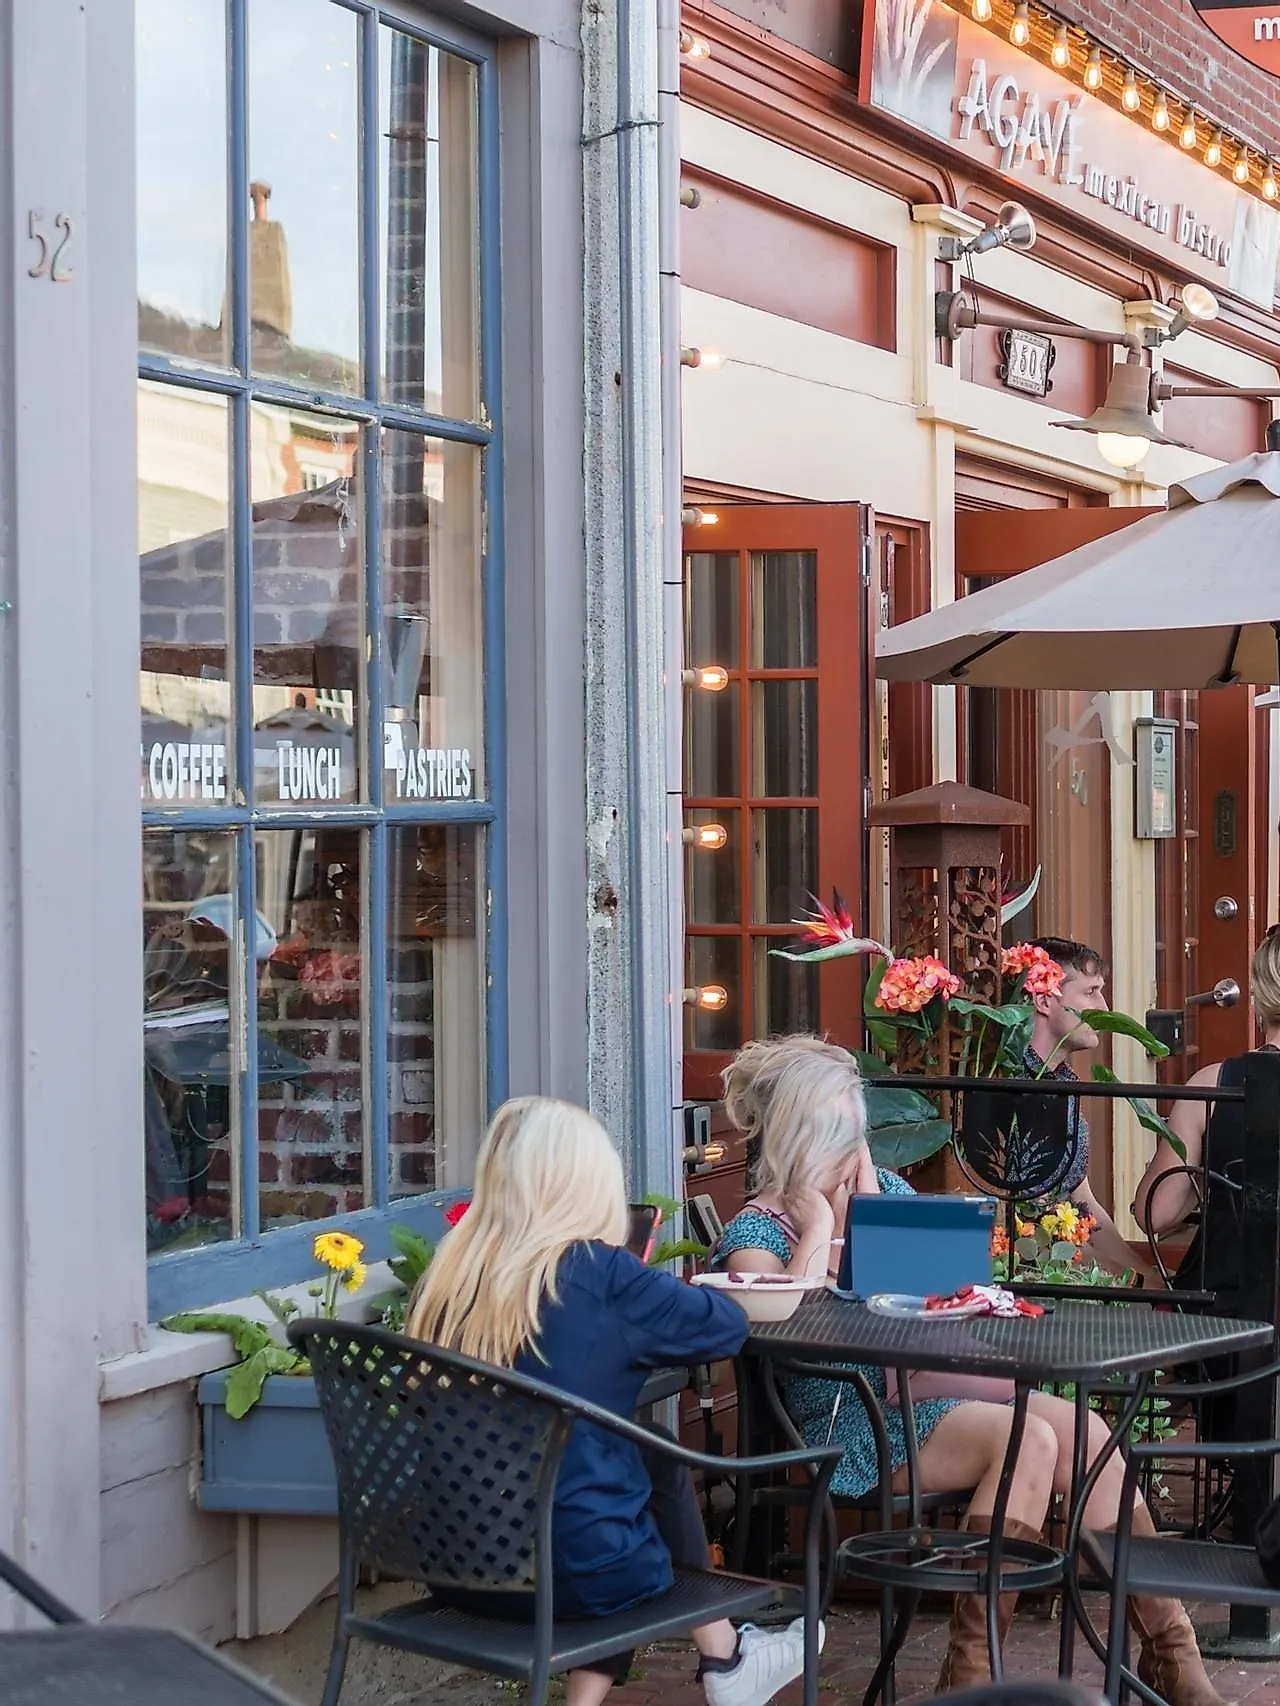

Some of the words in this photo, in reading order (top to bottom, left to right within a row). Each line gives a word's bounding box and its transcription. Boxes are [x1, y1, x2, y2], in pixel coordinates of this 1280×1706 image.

[1082, 162, 1170, 236] mexican
[1174, 203, 1232, 268] bistro
[27, 208, 76, 282] 52
[149, 742, 226, 800] COFFEE
[277, 745, 341, 800] LUNCH
[395, 746, 472, 798] PASTRIES
